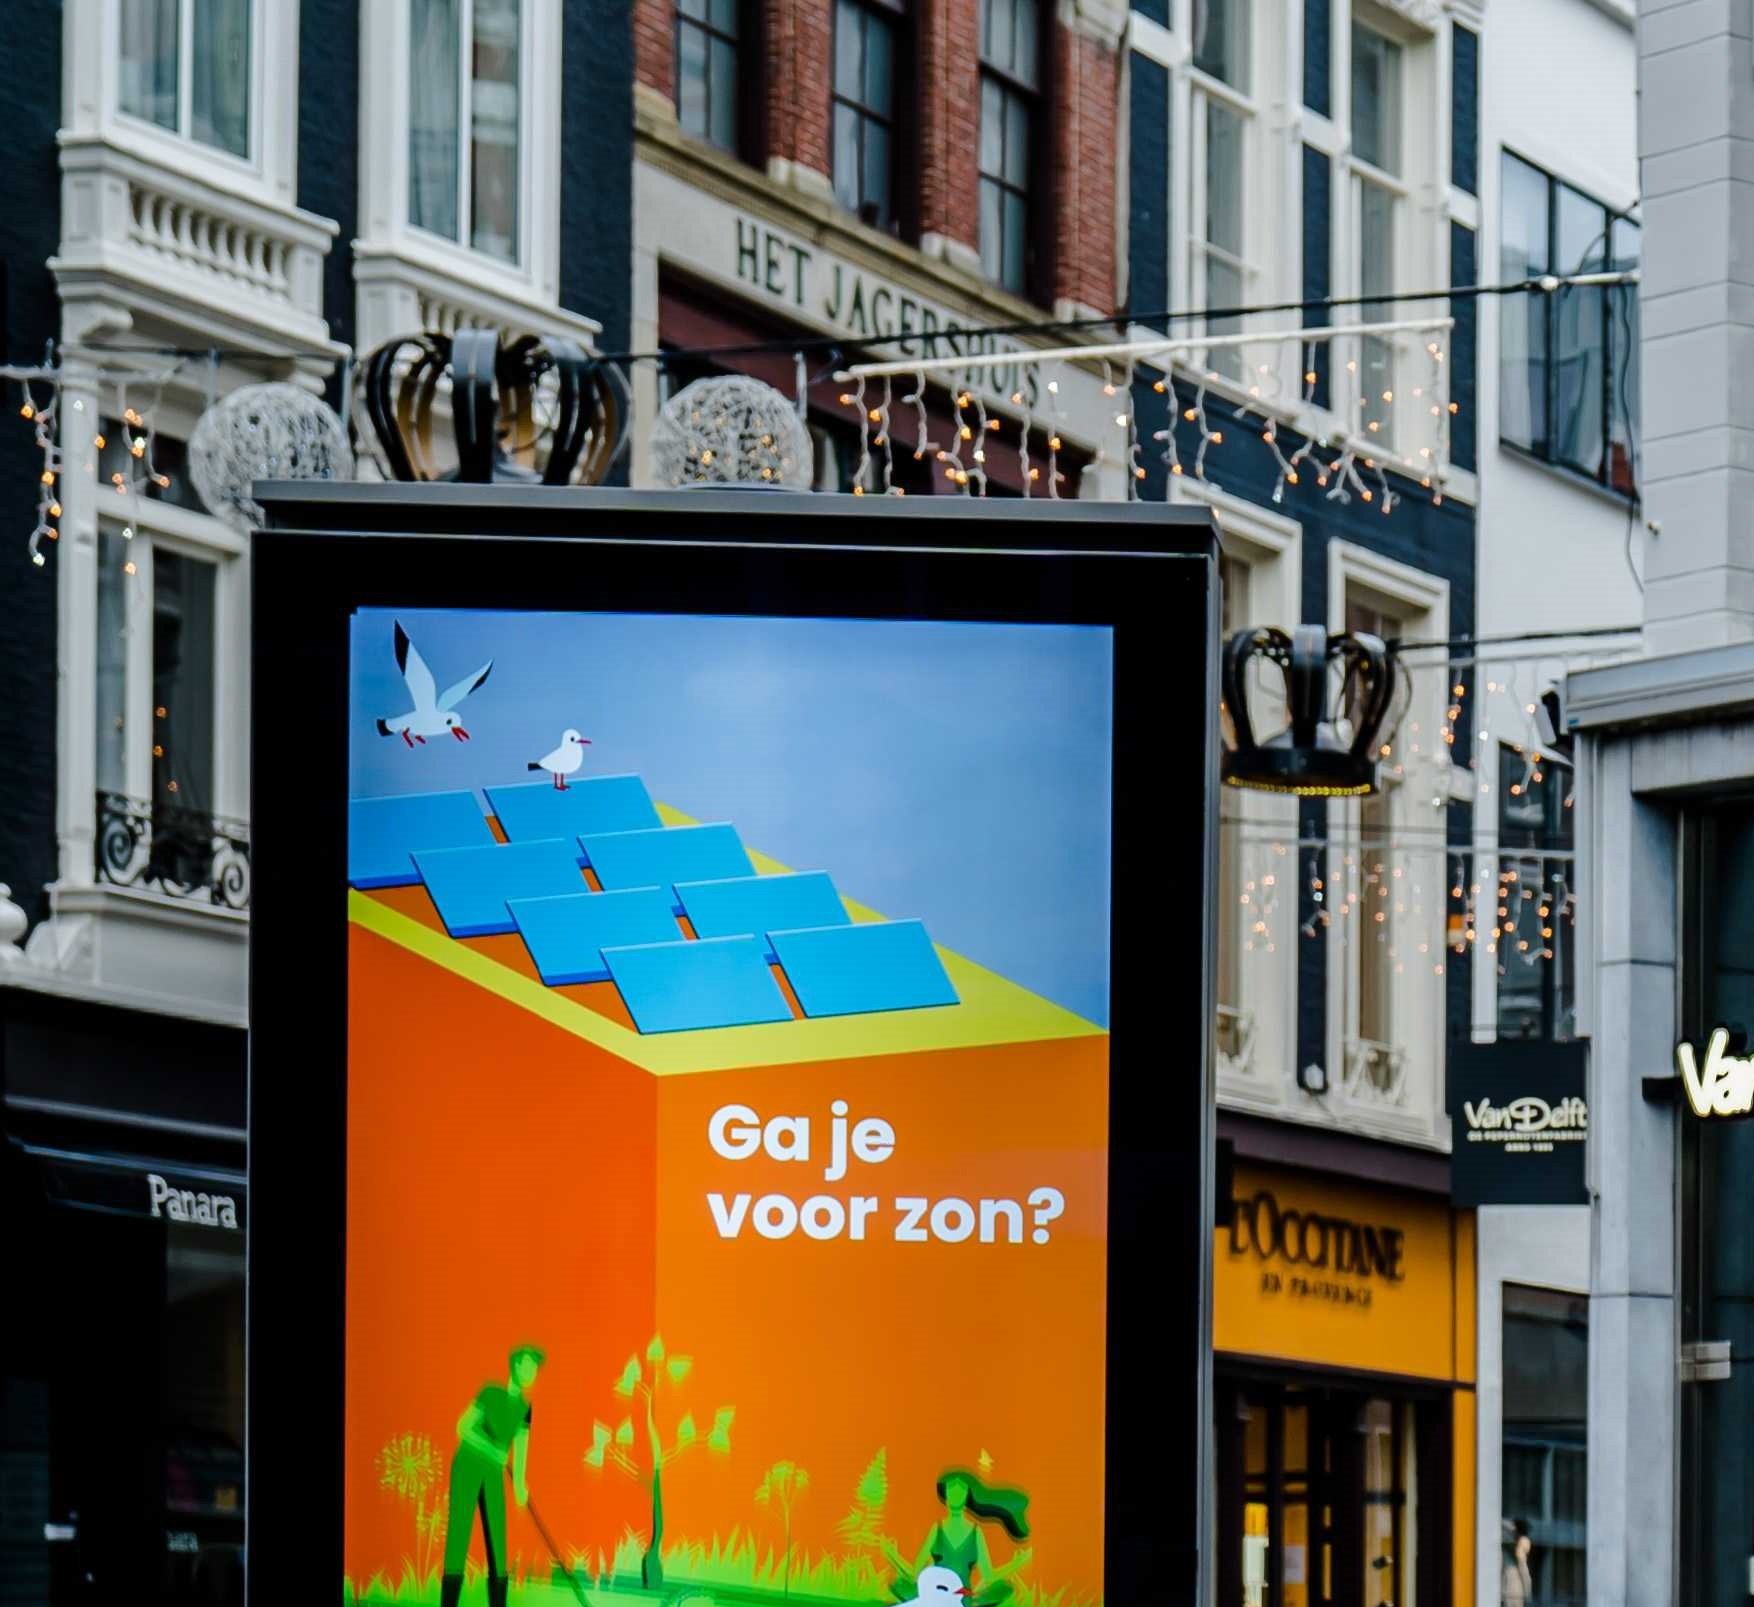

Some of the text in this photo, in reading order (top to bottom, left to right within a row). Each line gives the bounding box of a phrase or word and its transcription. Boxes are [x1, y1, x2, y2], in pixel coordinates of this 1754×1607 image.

[735, 215, 811, 306] HET
[708, 1100, 896, 1182] Ga je
[147, 1174, 238, 1229] Panara
[706, 1187, 1065, 1244] voor zon?
